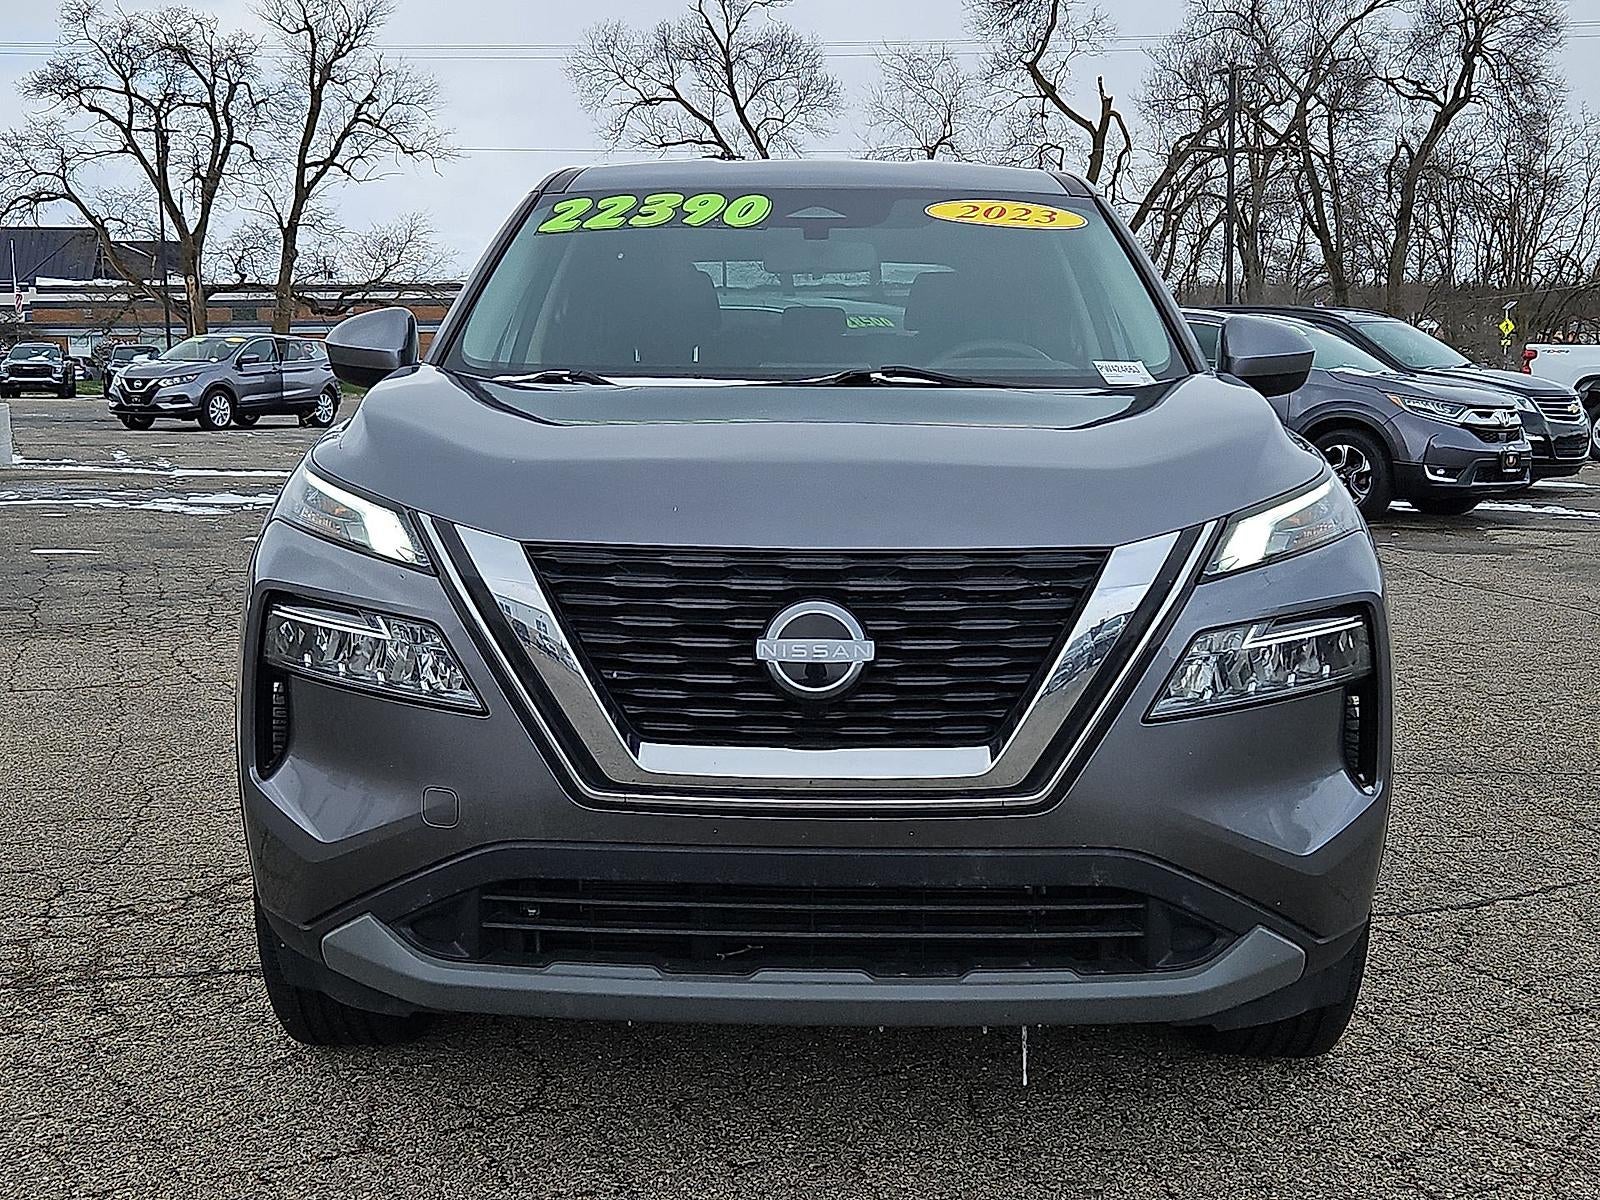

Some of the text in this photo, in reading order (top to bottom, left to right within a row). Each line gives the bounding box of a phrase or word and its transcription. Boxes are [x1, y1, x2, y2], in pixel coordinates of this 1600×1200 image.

[537, 192, 773, 233] 22390
[955, 204, 1059, 224] 2023
[759, 643, 871, 659] NISSAN
